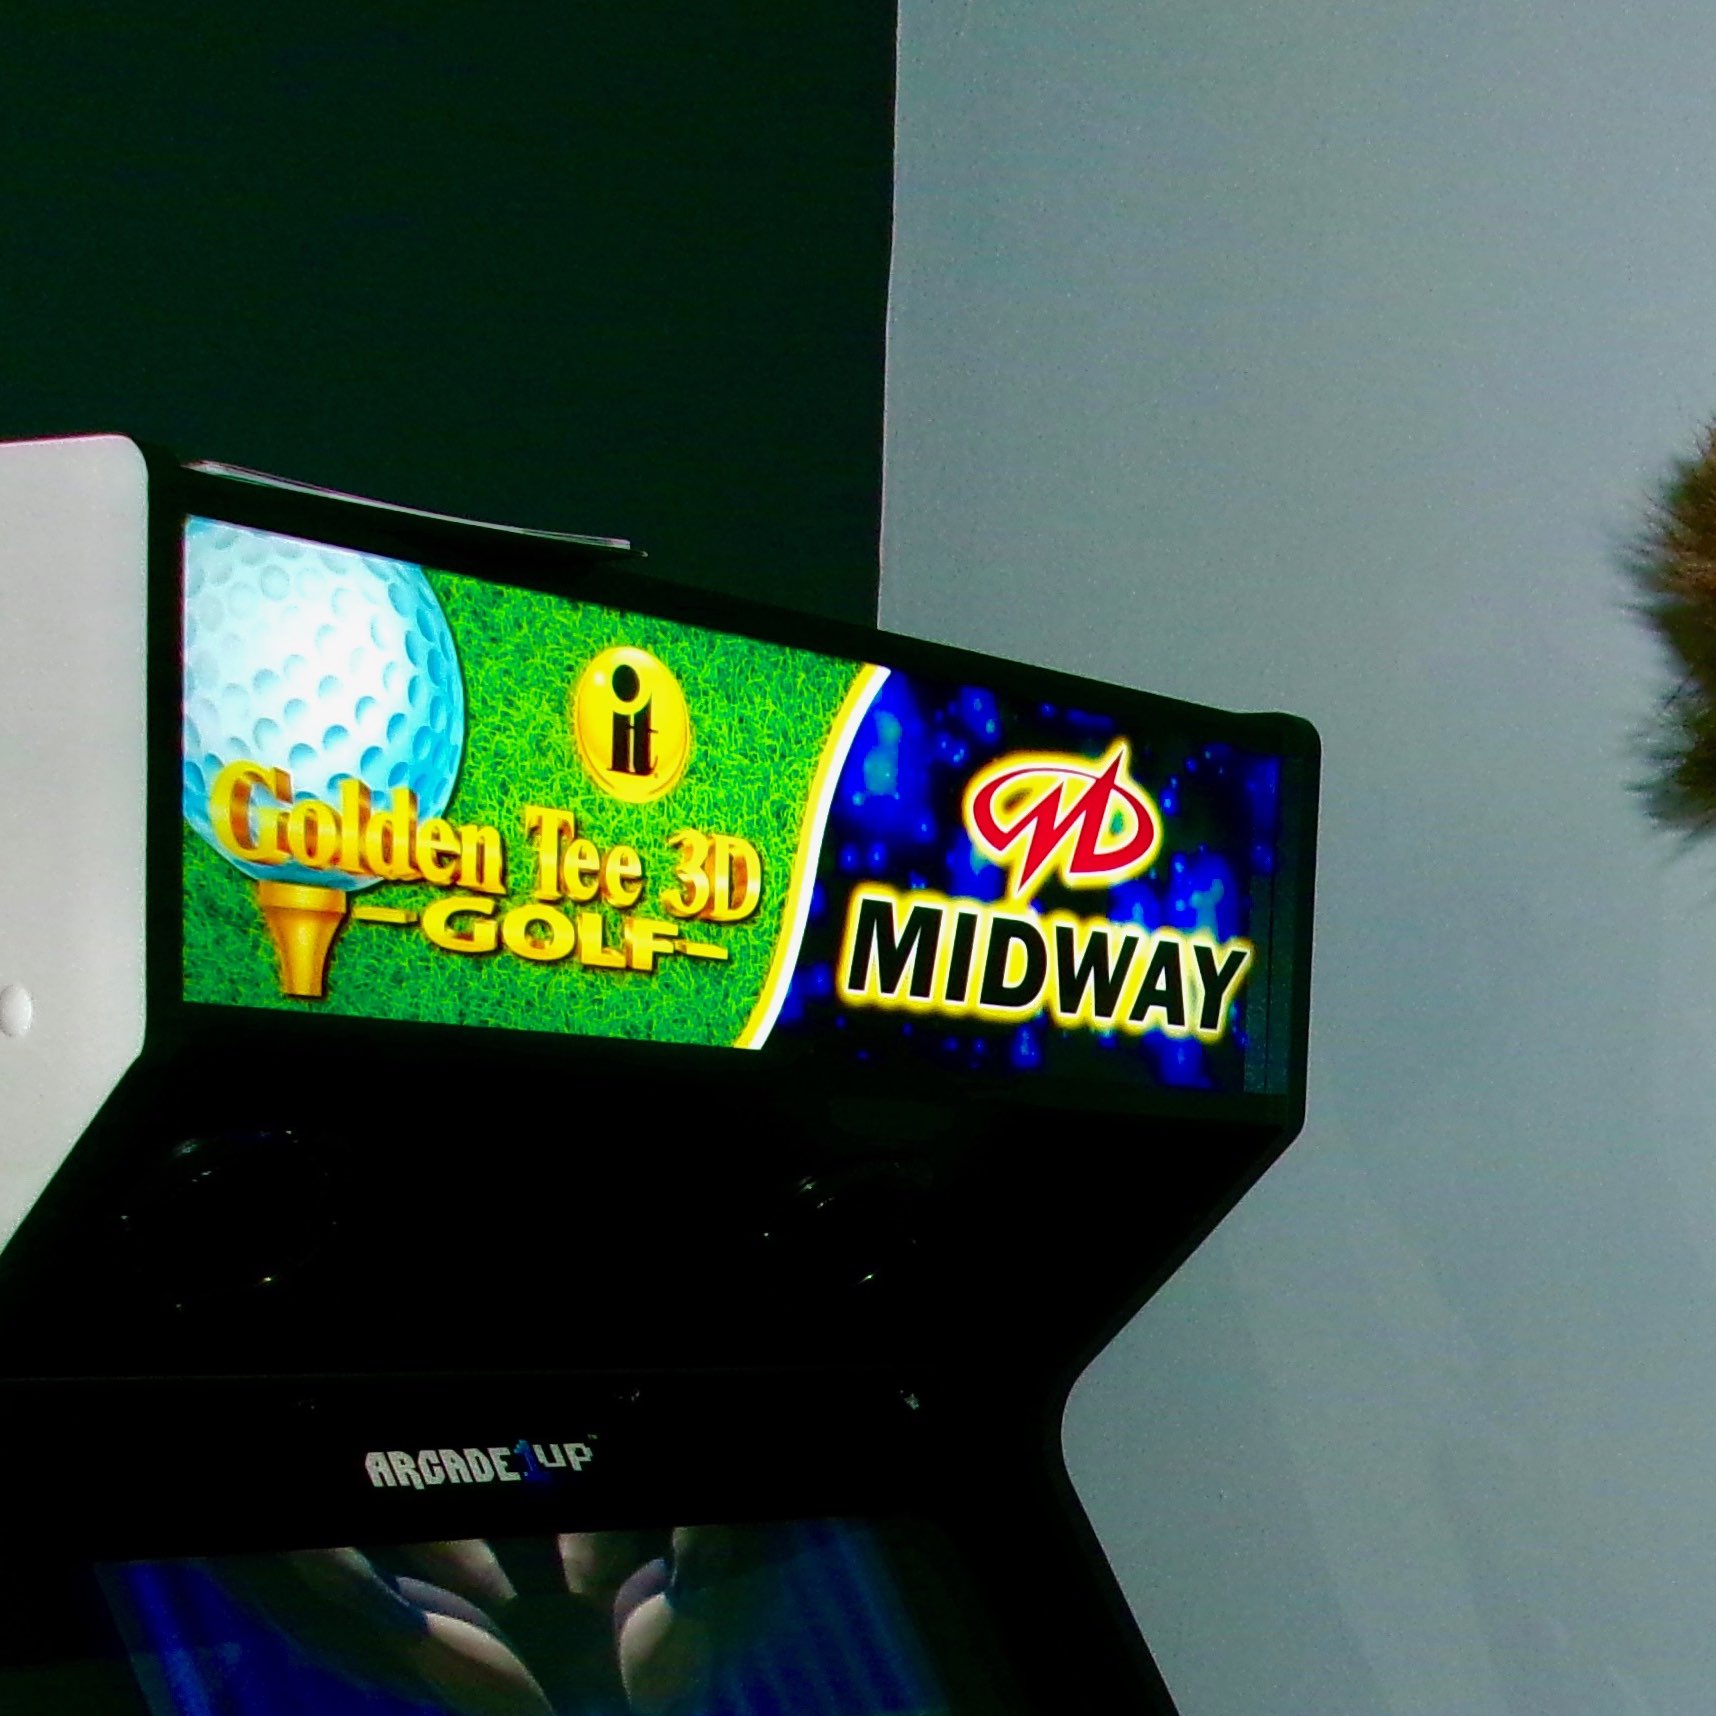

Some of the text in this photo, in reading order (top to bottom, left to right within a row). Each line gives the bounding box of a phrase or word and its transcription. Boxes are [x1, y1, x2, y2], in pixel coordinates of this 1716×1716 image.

[208, 759, 762, 923] Golden Tee 3D
[844, 894, 1251, 1034] MIDWAY
